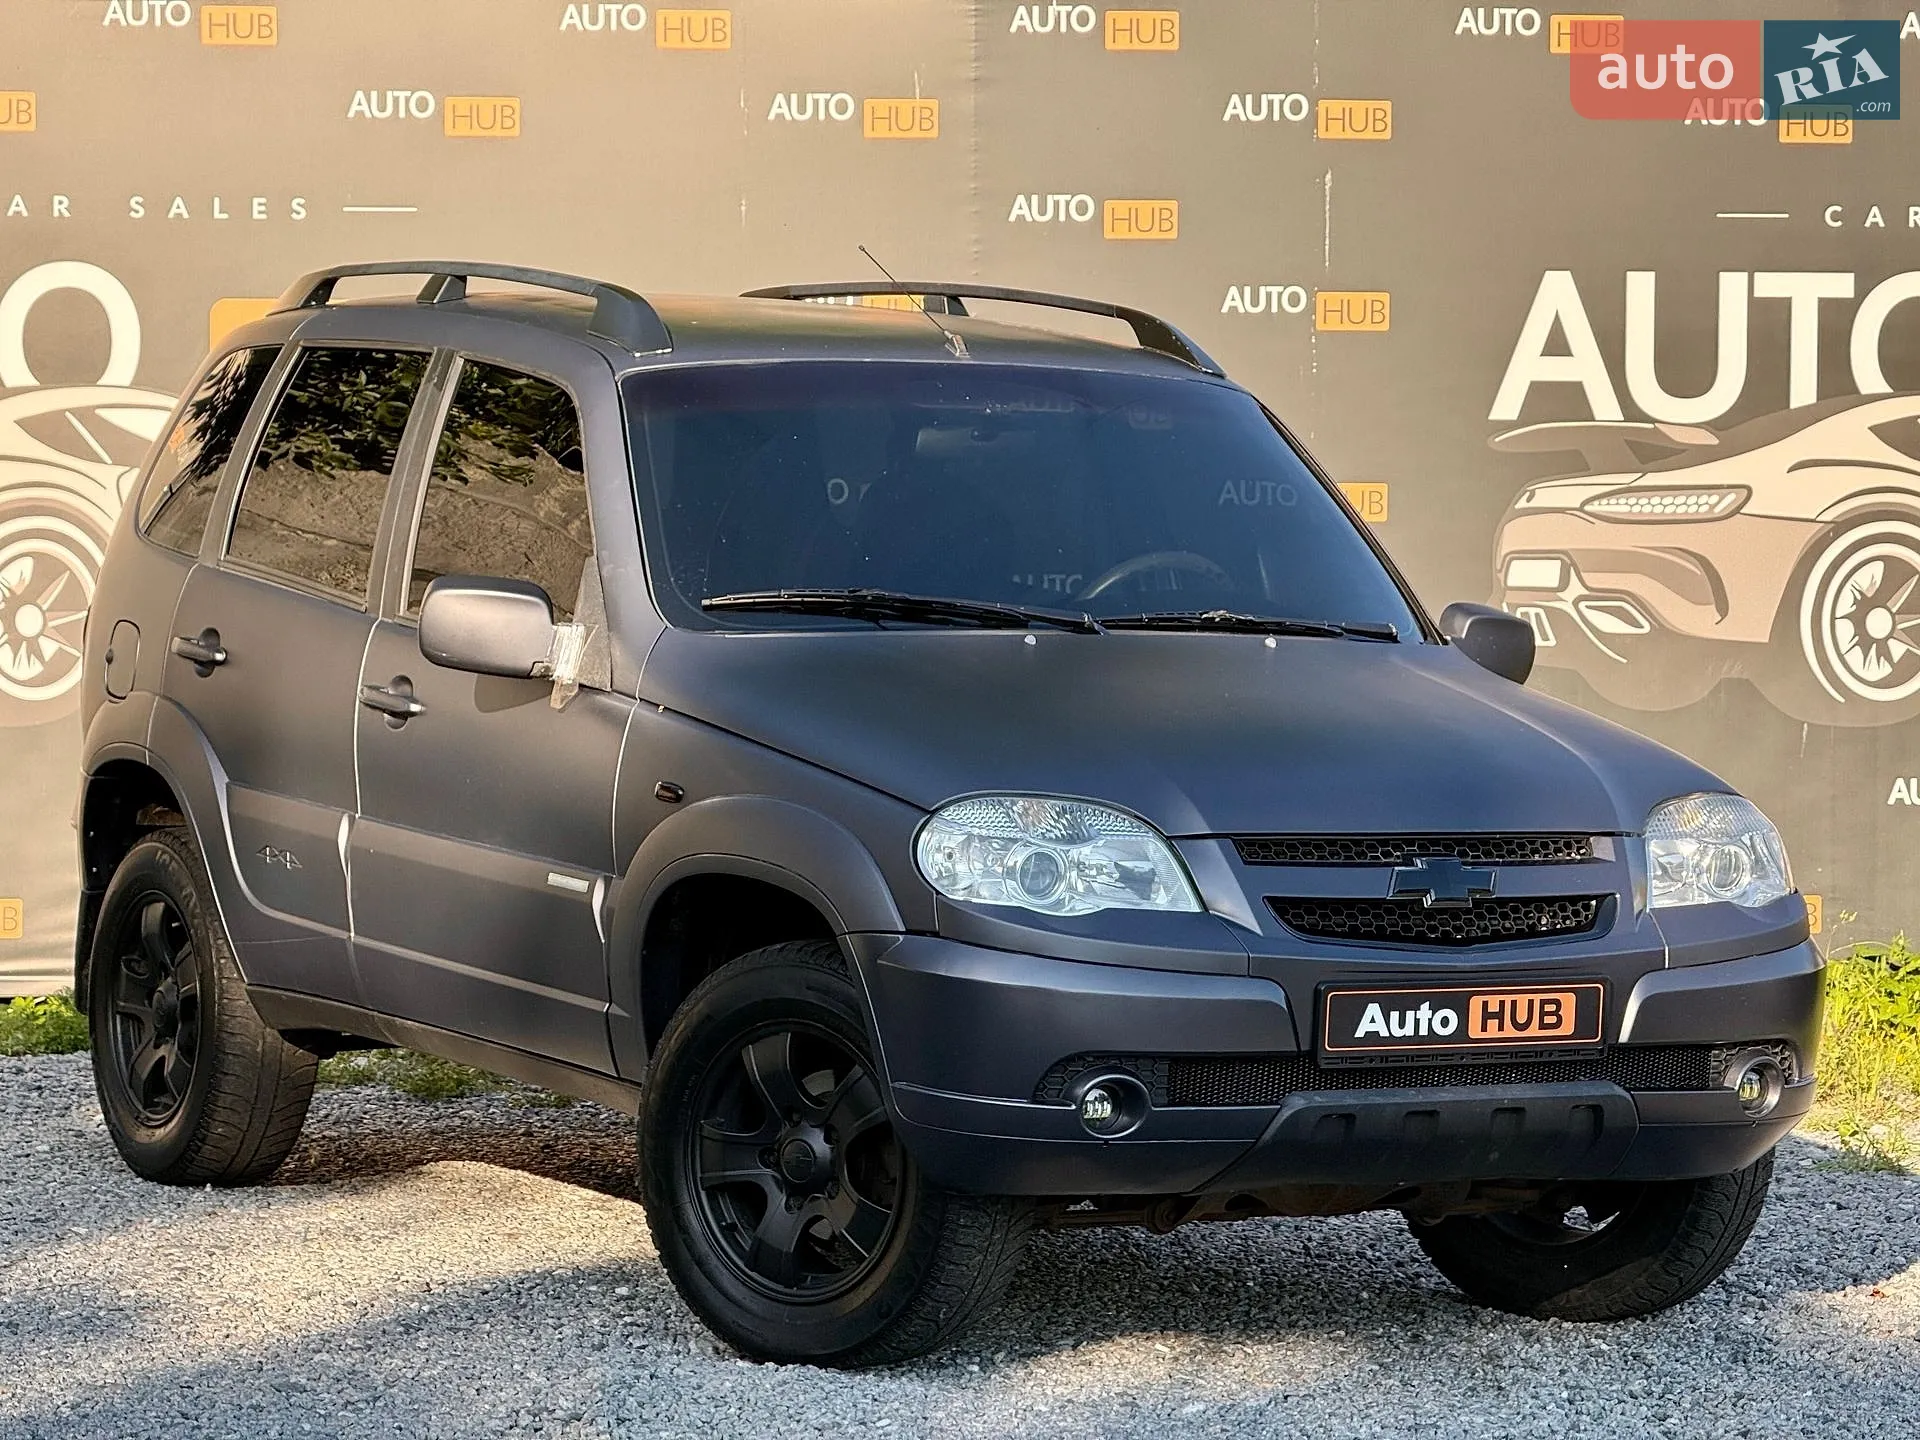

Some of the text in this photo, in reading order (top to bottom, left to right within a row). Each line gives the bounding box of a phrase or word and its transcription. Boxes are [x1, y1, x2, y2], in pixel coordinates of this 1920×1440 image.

[102, 0, 273, 39] AUTO HUB
[559, 4, 729, 44] AUTO HUB
[1009, 4, 1175, 45] AUTO HUB
[1455, 7, 1621, 48] AUTO HUB
[347, 90, 517, 131] AUTO HUB
[767, 93, 935, 133] AUTO HUB
[1222, 94, 1388, 133] AUTO HUB
[1684, 98, 1850, 137] AUTO HUB
[129, 196, 307, 220] SALES
[1008, 194, 1174, 234] AUTO HUB
[1824, 205, 1920, 228] CAR
[1220, 285, 1386, 326] AUTO HUB
[1354, 997, 1563, 1038] Auto HUB
